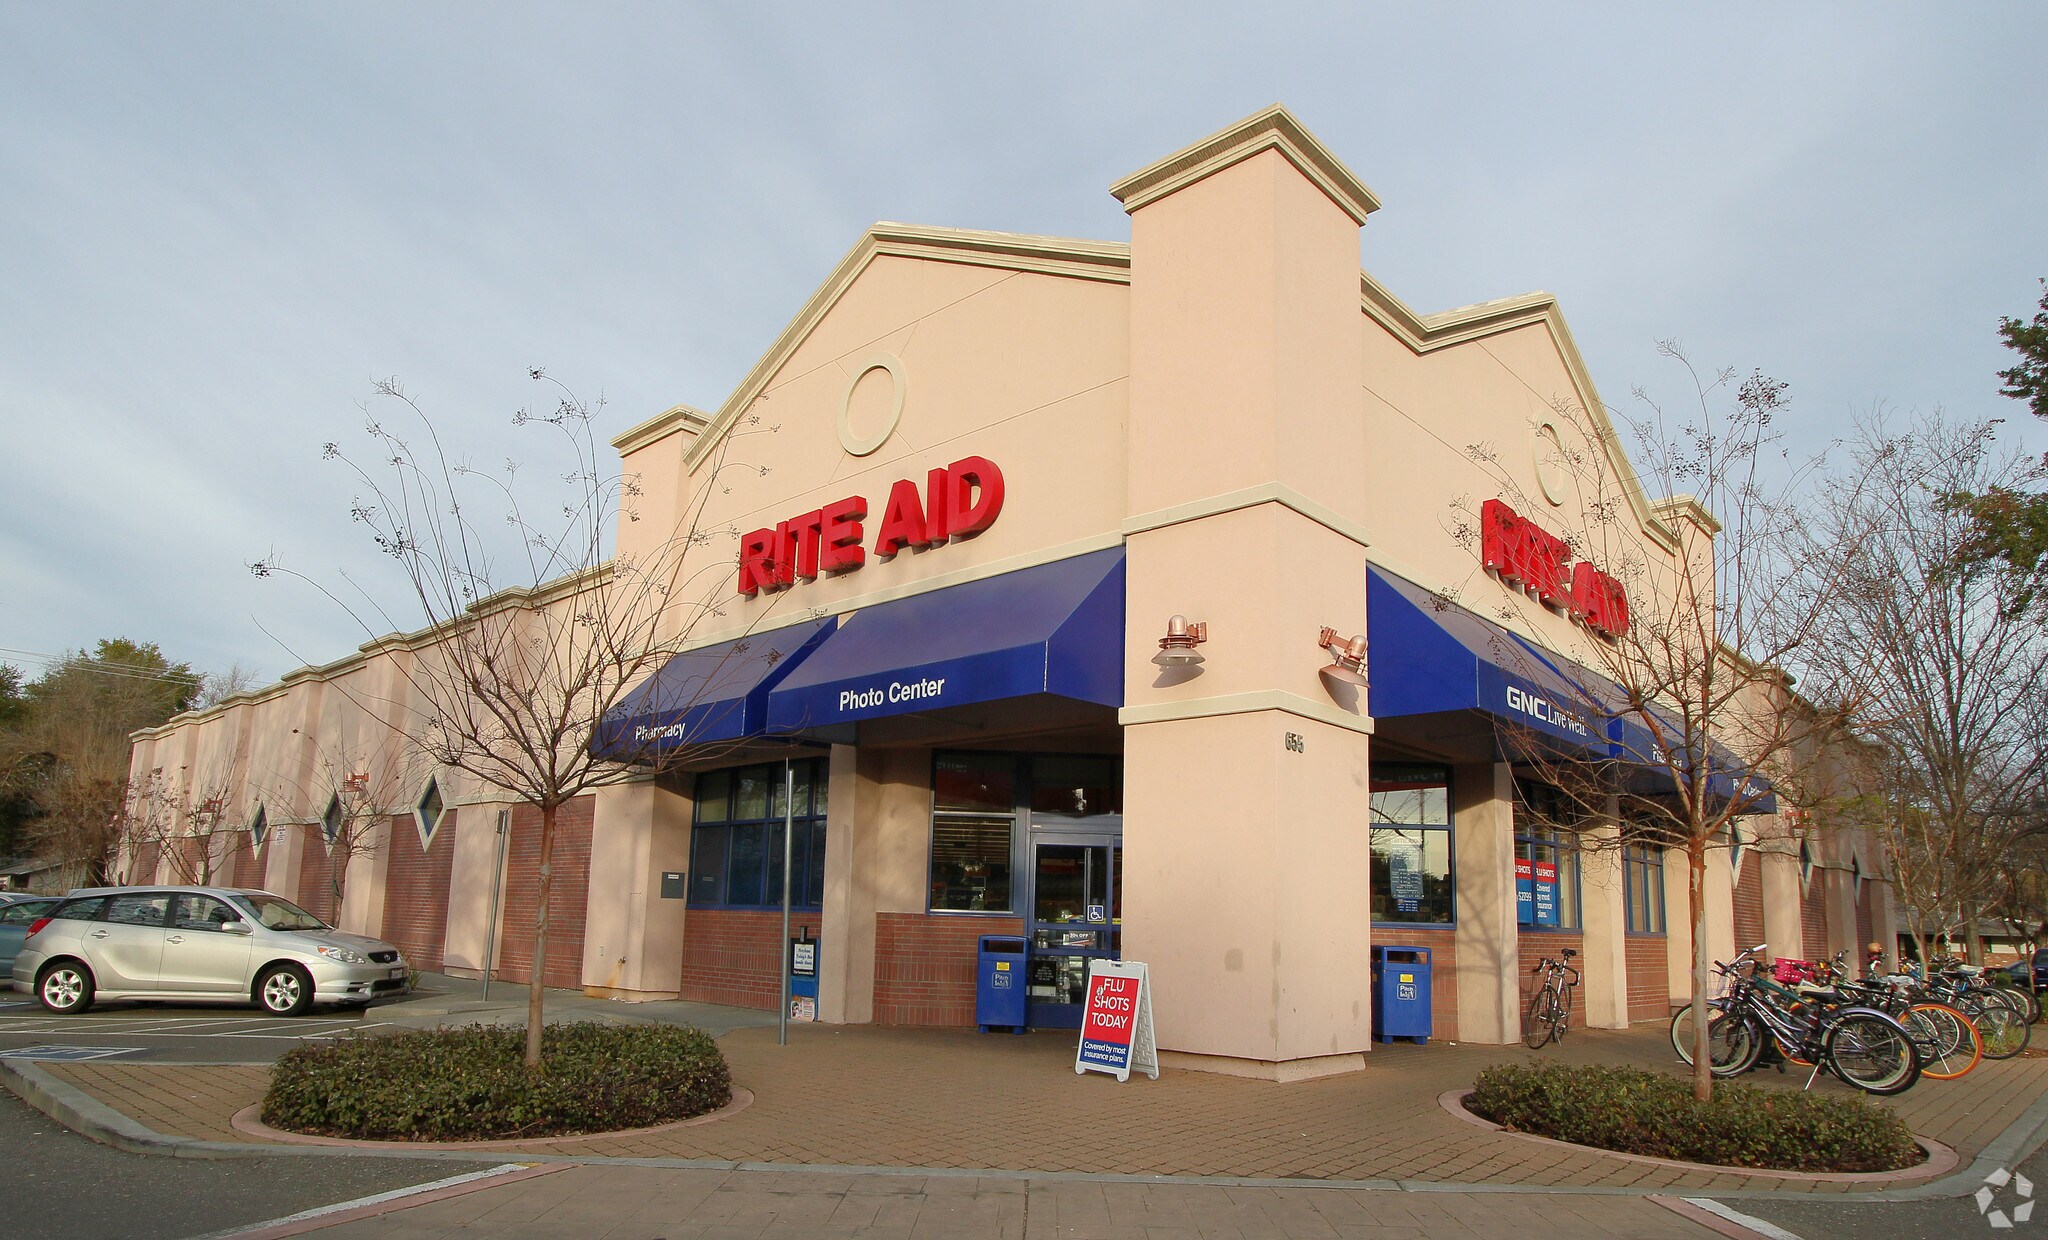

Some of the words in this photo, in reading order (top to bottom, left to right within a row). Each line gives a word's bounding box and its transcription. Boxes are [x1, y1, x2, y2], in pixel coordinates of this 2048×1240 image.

[738, 495, 868, 596] RITE
[874, 456, 1005, 556] AID
[1482, 498, 1573, 609] RITE
[839, 686, 883, 711] Photo
[888, 677, 945, 704] Center
[1507, 685, 1546, 721] GNC
[635, 722, 686, 741] Pharmacy
[1284, 731, 1305, 754] 655
[1103, 978, 1125, 993] FLU
[1093, 995, 1130, 1012] SHOTS
[1092, 1012, 1129, 1030] TODAY
[1084, 1041, 1106, 1052] Covered
[1106, 1044, 1113, 1054] by
[1113, 1046, 1127, 1055] most
[1084, 1049, 1109, 1061] insurance
[1108, 1053, 1125, 1064] plans.
